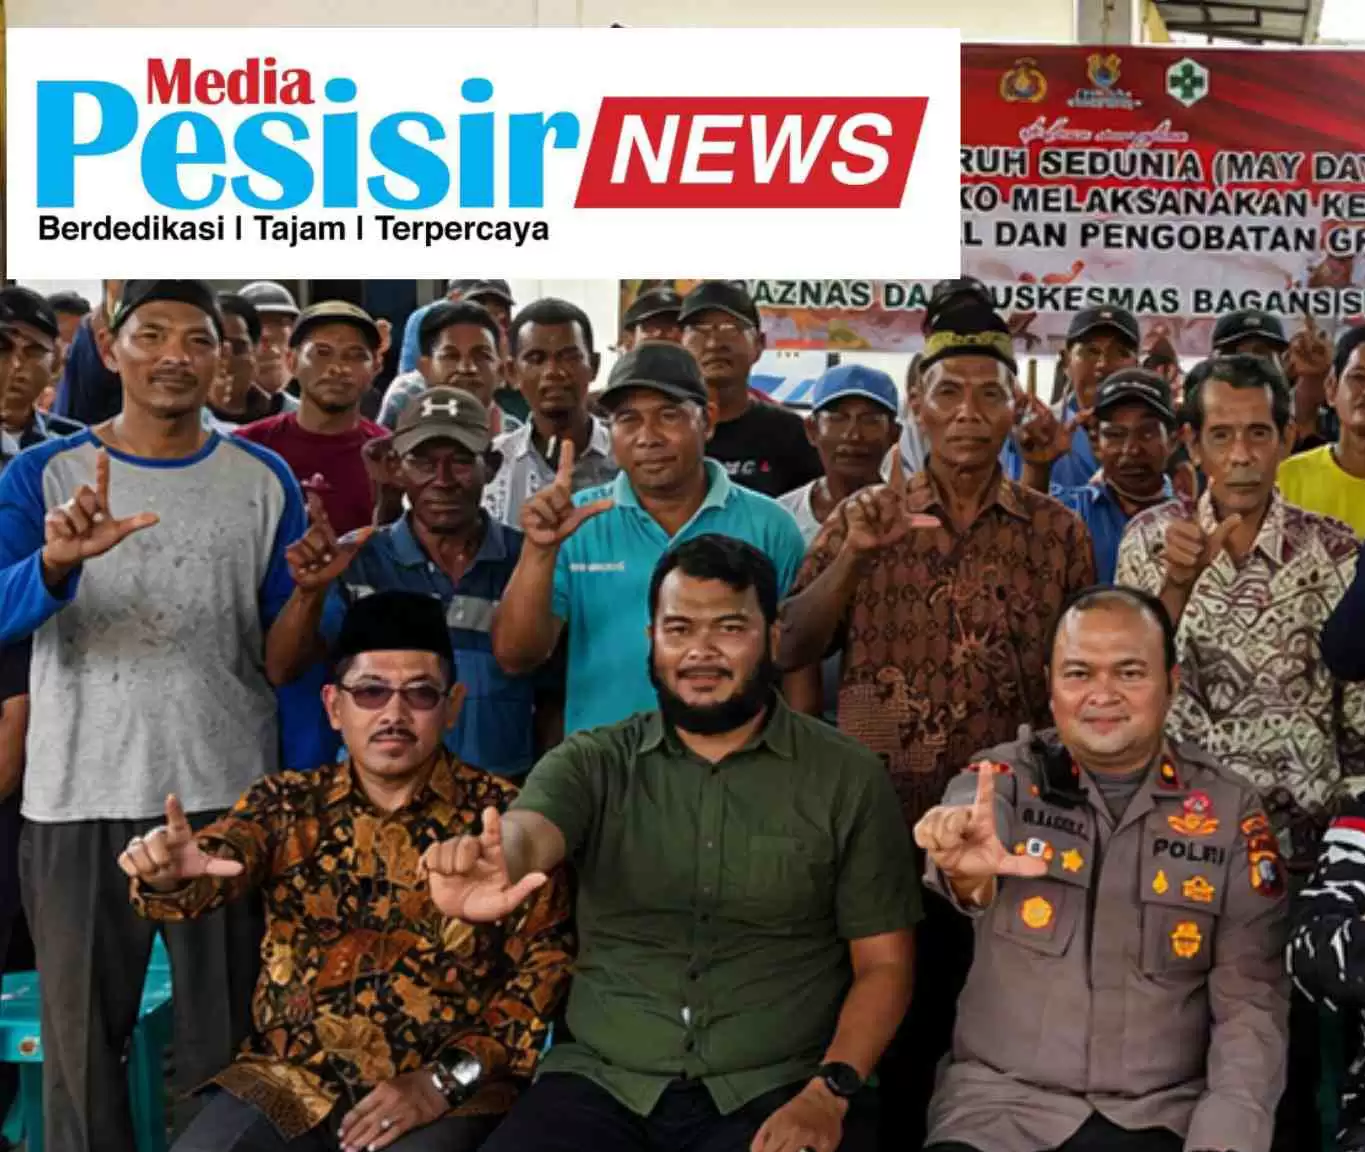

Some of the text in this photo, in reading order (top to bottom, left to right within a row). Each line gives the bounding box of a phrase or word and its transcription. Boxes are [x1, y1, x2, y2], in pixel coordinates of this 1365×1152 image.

[1041, 151, 1200, 178] SEDUNIA
[1214, 153, 1301, 184] (MAY
[1012, 187, 1308, 216] MELAKSANAKAN
[996, 221, 1065, 247] DAN
[1080, 222, 1316, 250] PENGOBATAN
[885, 283, 928, 307] DA
[990, 285, 1179, 313] USKESMAS
[1152, 838, 1224, 866] POLRI
